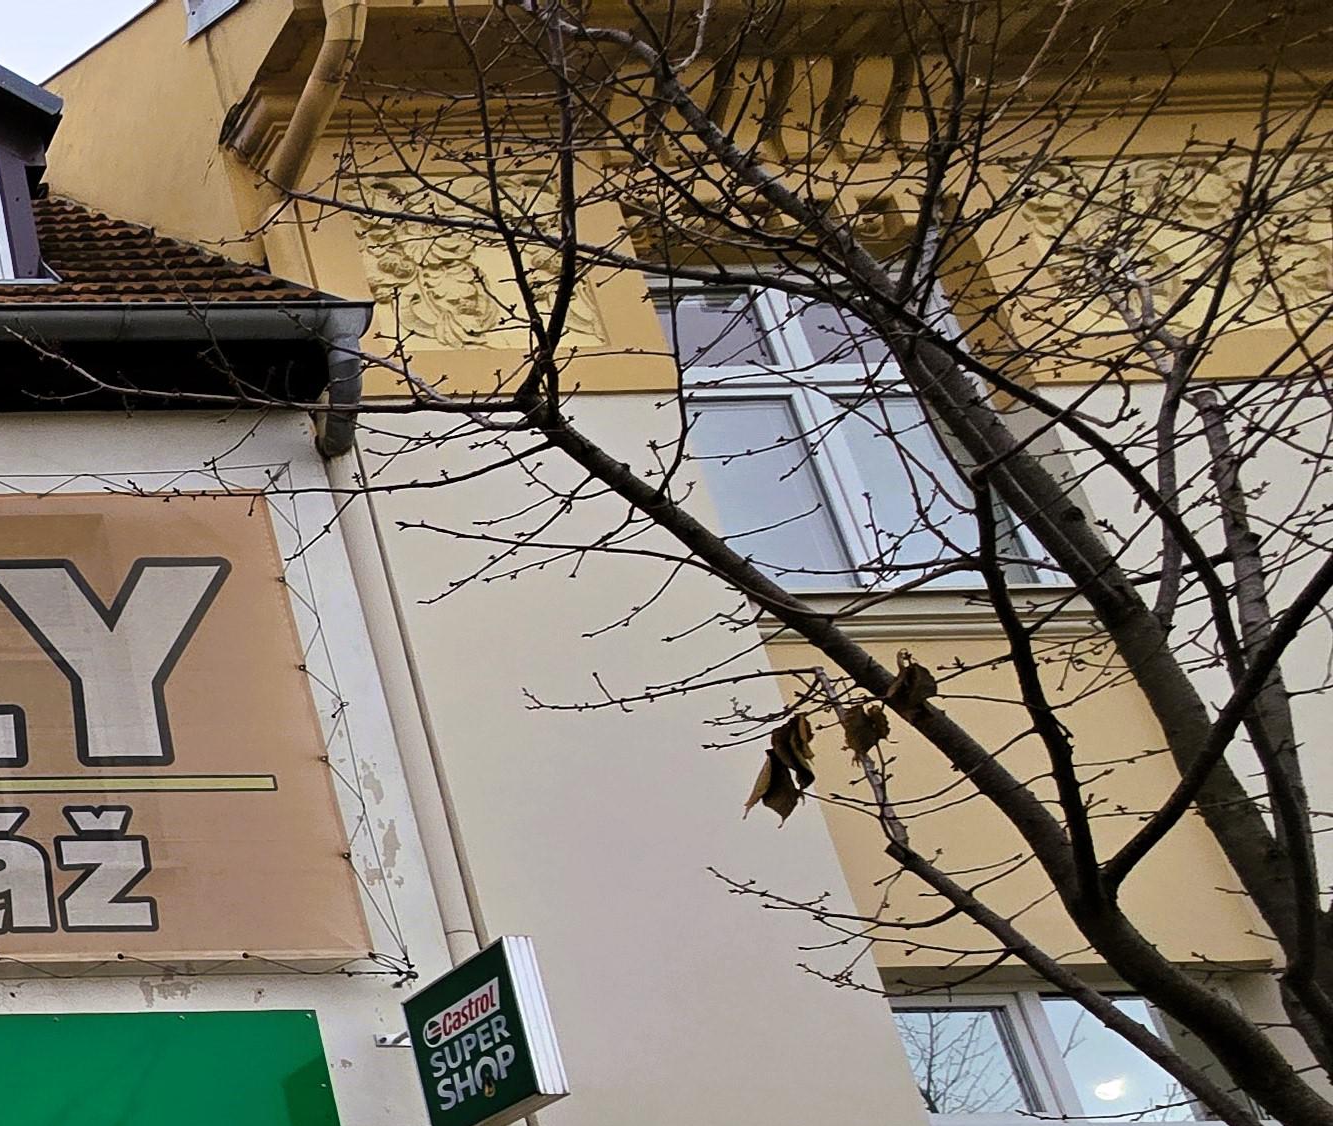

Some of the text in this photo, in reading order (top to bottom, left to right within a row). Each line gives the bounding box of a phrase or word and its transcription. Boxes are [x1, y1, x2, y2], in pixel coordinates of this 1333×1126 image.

[441, 985, 497, 1037] Castrol
[430, 1014, 512, 1078] SUPER
[436, 1044, 516, 1111] SHOP
